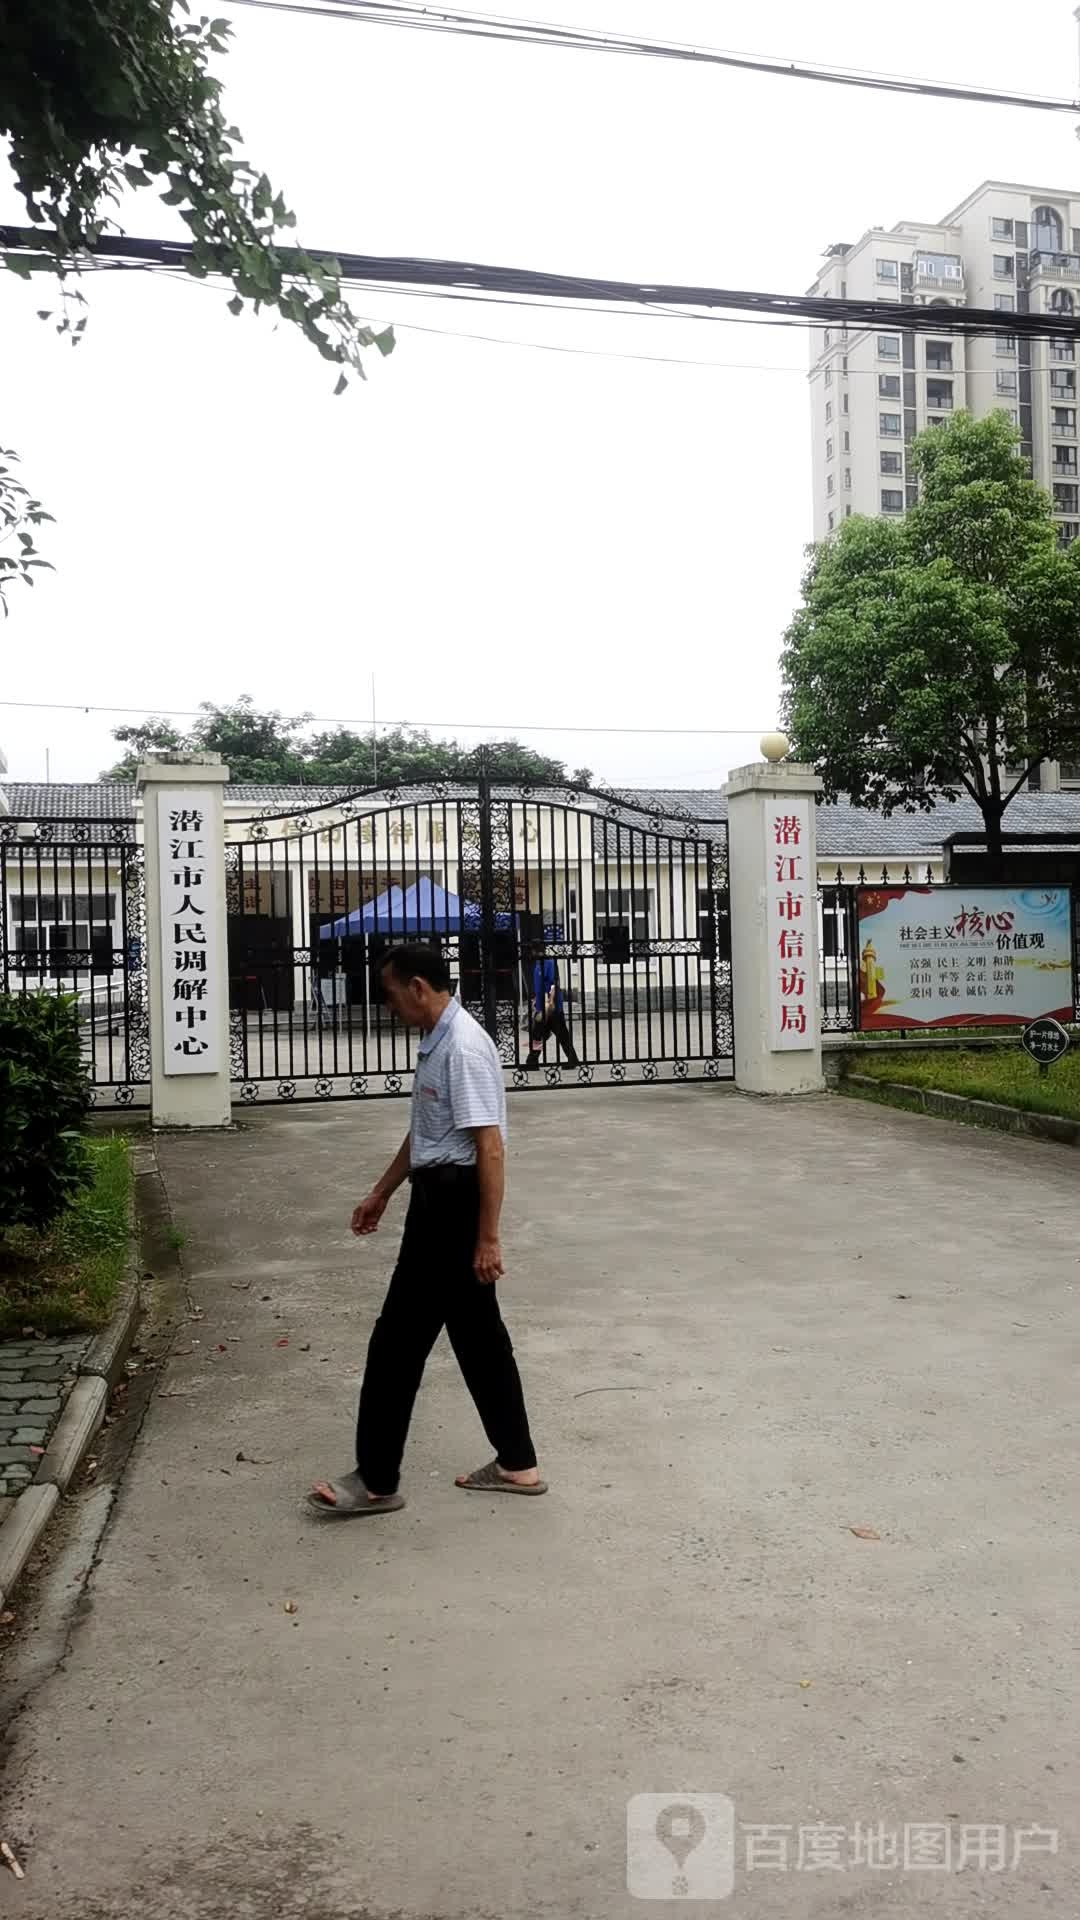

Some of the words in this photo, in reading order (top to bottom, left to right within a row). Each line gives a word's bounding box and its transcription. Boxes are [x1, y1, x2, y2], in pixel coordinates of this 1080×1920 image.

[168, 809, 209, 1056] 潜江市人民调解中心
[773, 815, 807, 1034] 潜江市信访局
[899, 926, 955, 941] 社会主义
[953, 904, 1015, 938] 核心
[996, 932, 1045, 950] 价值观
[909, 957, 932, 969] 富强
[936, 957, 959, 968] 民主
[966, 956, 986, 968] 文明
[937, 973, 960, 984] 平等
[965, 972, 987, 983] 公正
[992, 970, 1014, 982] 法治
[937, 986, 961, 998] 敬业
[965, 985, 987, 997] 诚信
[992, 983, 1014, 996] 友善
